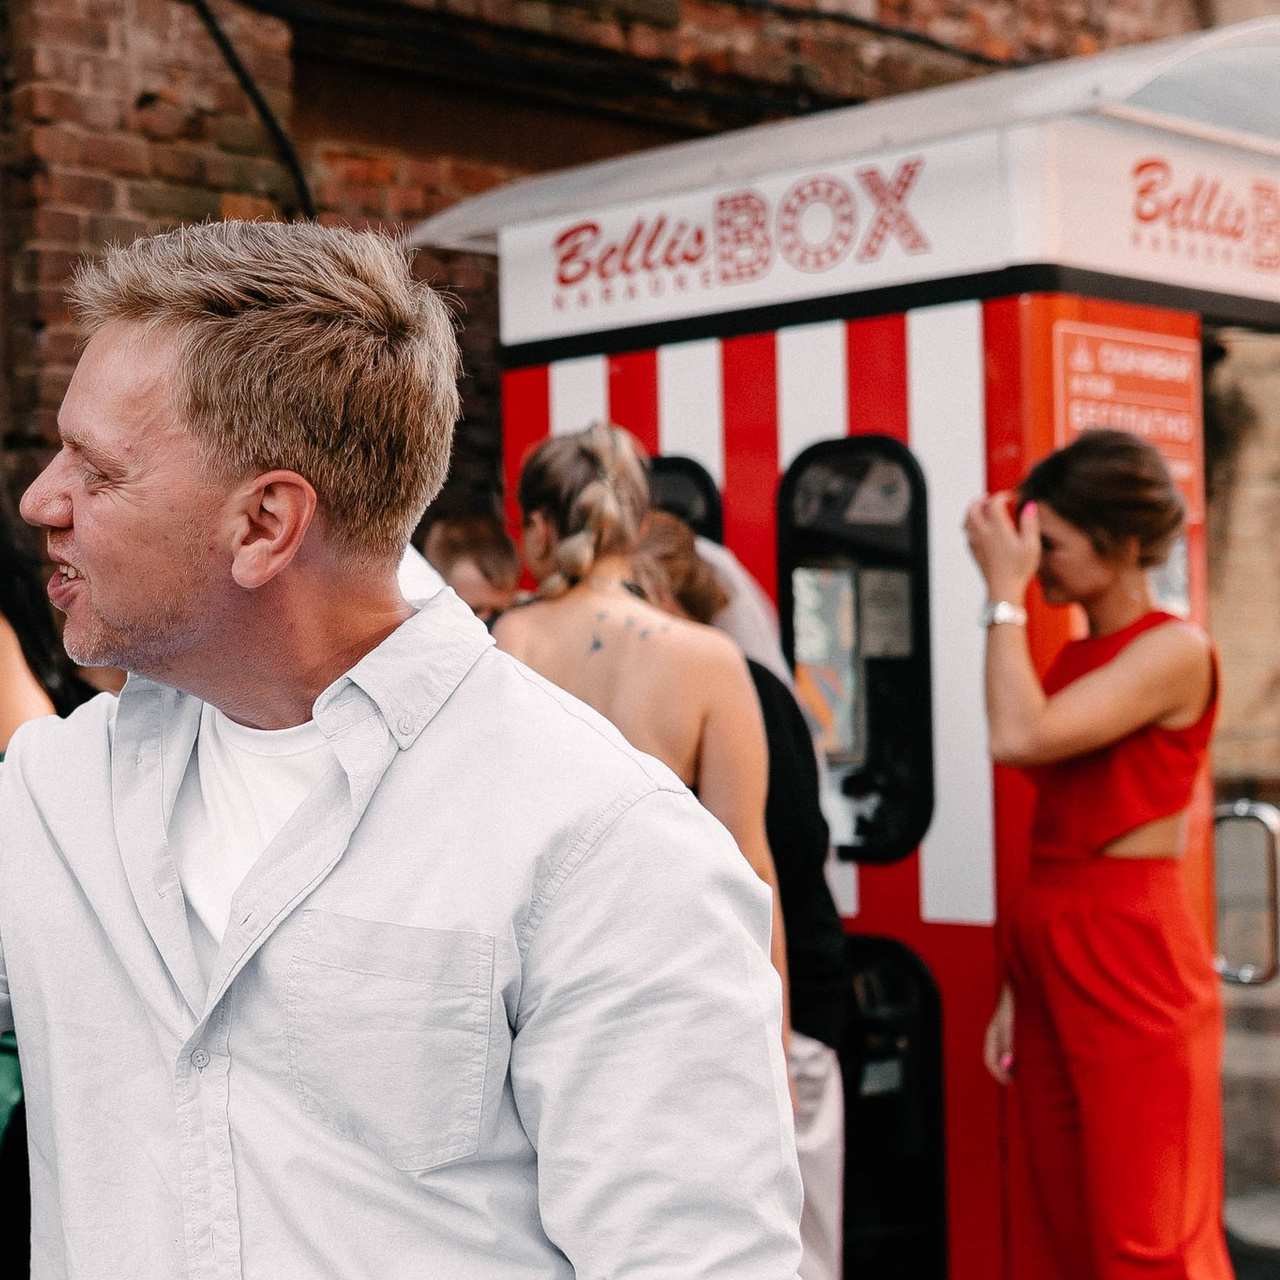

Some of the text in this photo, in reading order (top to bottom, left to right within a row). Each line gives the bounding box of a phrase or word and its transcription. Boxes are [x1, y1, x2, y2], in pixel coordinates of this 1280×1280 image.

[553, 156, 932, 287] Bellis BOX
[1132, 157, 1246, 239] Bellis
